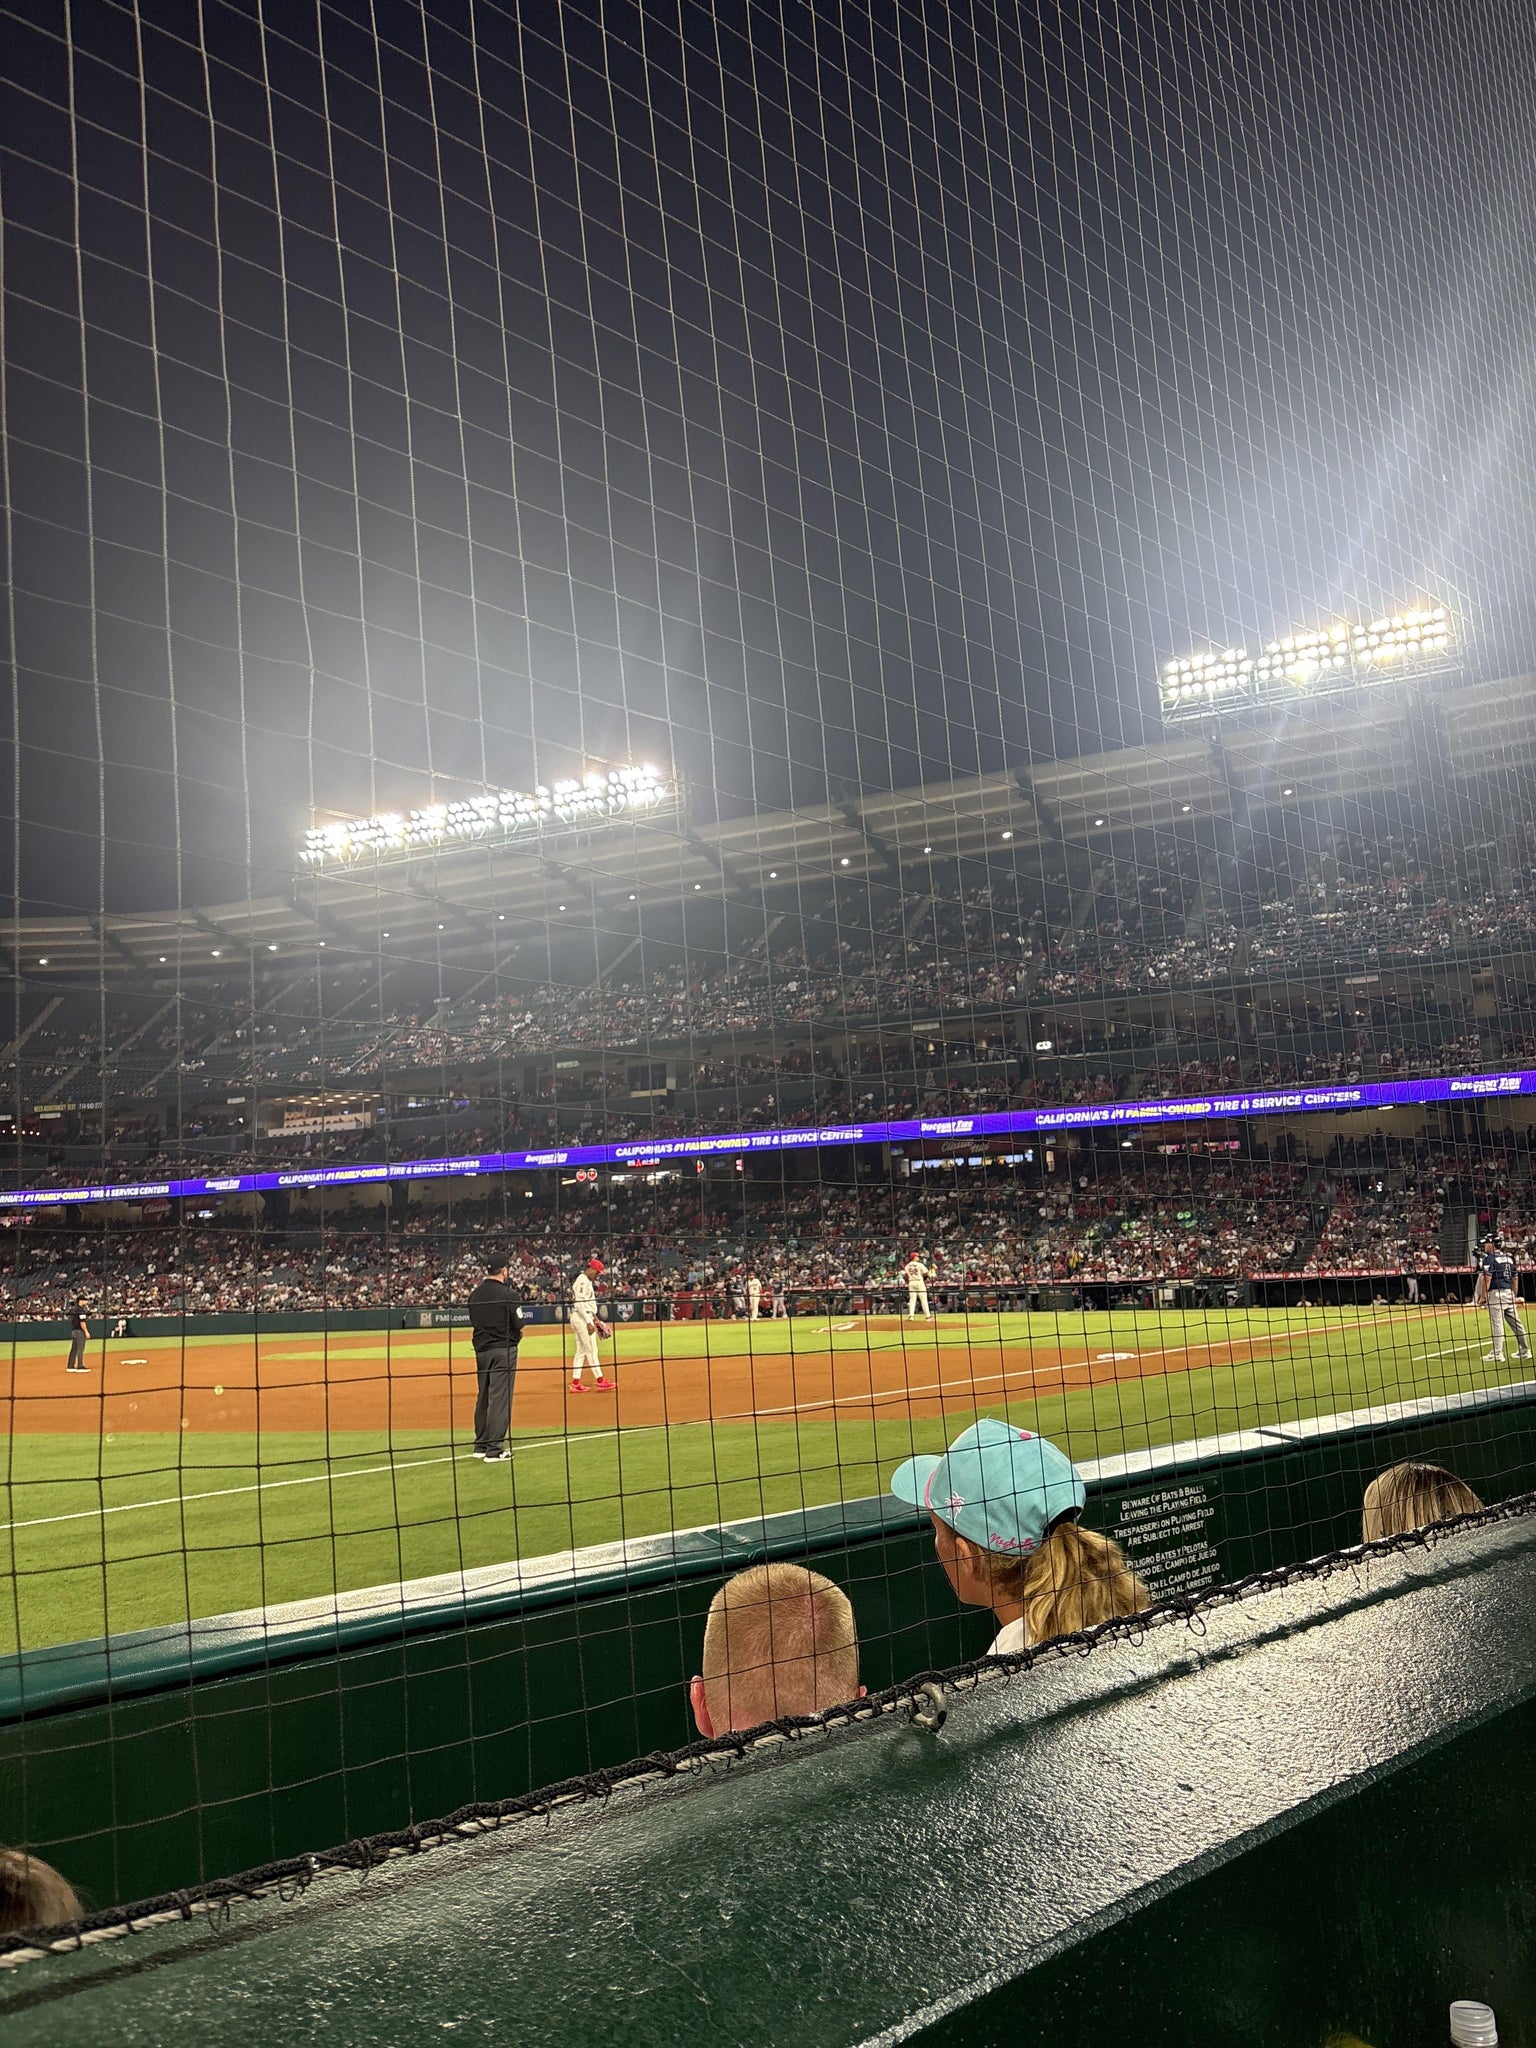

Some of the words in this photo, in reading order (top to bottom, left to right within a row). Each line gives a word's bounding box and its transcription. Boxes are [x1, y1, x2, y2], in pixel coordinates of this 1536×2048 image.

[1035, 1110, 1109, 1125] CALIFORNIA'S
[1126, 1104, 1211, 1118] FAMILY-OWNED
[1213, 1099, 1239, 1111] TIRE
[1240, 1099, 1250, 1109] &
[1252, 1096, 1302, 1108] SERVICE
[1304, 1091, 1361, 1104] CENTERS
[615, 1144, 673, 1157] CALIFORNIA'S
[685, 1138, 750, 1151] FAMILY-OWNED
[752, 1136, 771, 1146] TIRE
[772, 1136, 779, 1144] &
[781, 1132, 818, 1143] SERVICE
[820, 1129, 863, 1141] CENTERS
[278, 1173, 325, 1185] CALIFORNIA'S
[389, 1167, 405, 1175] TIRE
[413, 1163, 444, 1174] SERVICE
[111, 1187, 139, 1197] SERVICE
[140, 1185, 169, 1195] CENTERS
[1120, 1508, 1149, 1521] LEAVING
[1149, 1504, 1162, 1514] THE
[1163, 1499, 1188, 1511] PLAYING
[1189, 1495, 1207, 1506] FIELD
[1121, 1496, 1150, 1510] BEWARE
[1151, 1494, 1160, 1503] OF
[1161, 1491, 1178, 1500] BATS
[1178, 1488, 1184, 1497] &
[1184, 1485, 1204, 1496] BALLS
[1113, 1521, 1160, 1539] TRESPASSERS
[1161, 1518, 1171, 1527] ON
[1171, 1512, 1196, 1525] PLAYING
[1197, 1507, 1214, 1518] FIELD
[1127, 1536, 1142, 1547] ARE
[1142, 1529, 1171, 1543] SUBJECT
[1172, 1526, 1180, 1536] TO
[1181, 1520, 1205, 1533] ARREST
[1126, 1555, 1155, 1570] PELIGRO
[1155, 1548, 1177, 1562] BATES
[1181, 1541, 1208, 1556] PELOTAS
[1152, 1563, 1165, 1574] DEL
[1165, 1558, 1187, 1570] CAMPO
[1188, 1554, 1197, 1564] DE
[1197, 1548, 1217, 1561] JUEGO
[1150, 1580, 1159, 1591] EN
[1160, 1578, 1168, 1588] EL
[1168, 1571, 1191, 1584] CAMPO
[1192, 1568, 1200, 1578] DE
[1200, 1563, 1220, 1576] JUEGO
[1151, 1587, 1175, 1601] SUJETO
[1176, 1583, 1185, 1593] AL
[1185, 1575, 1212, 1590] ARRESTO
